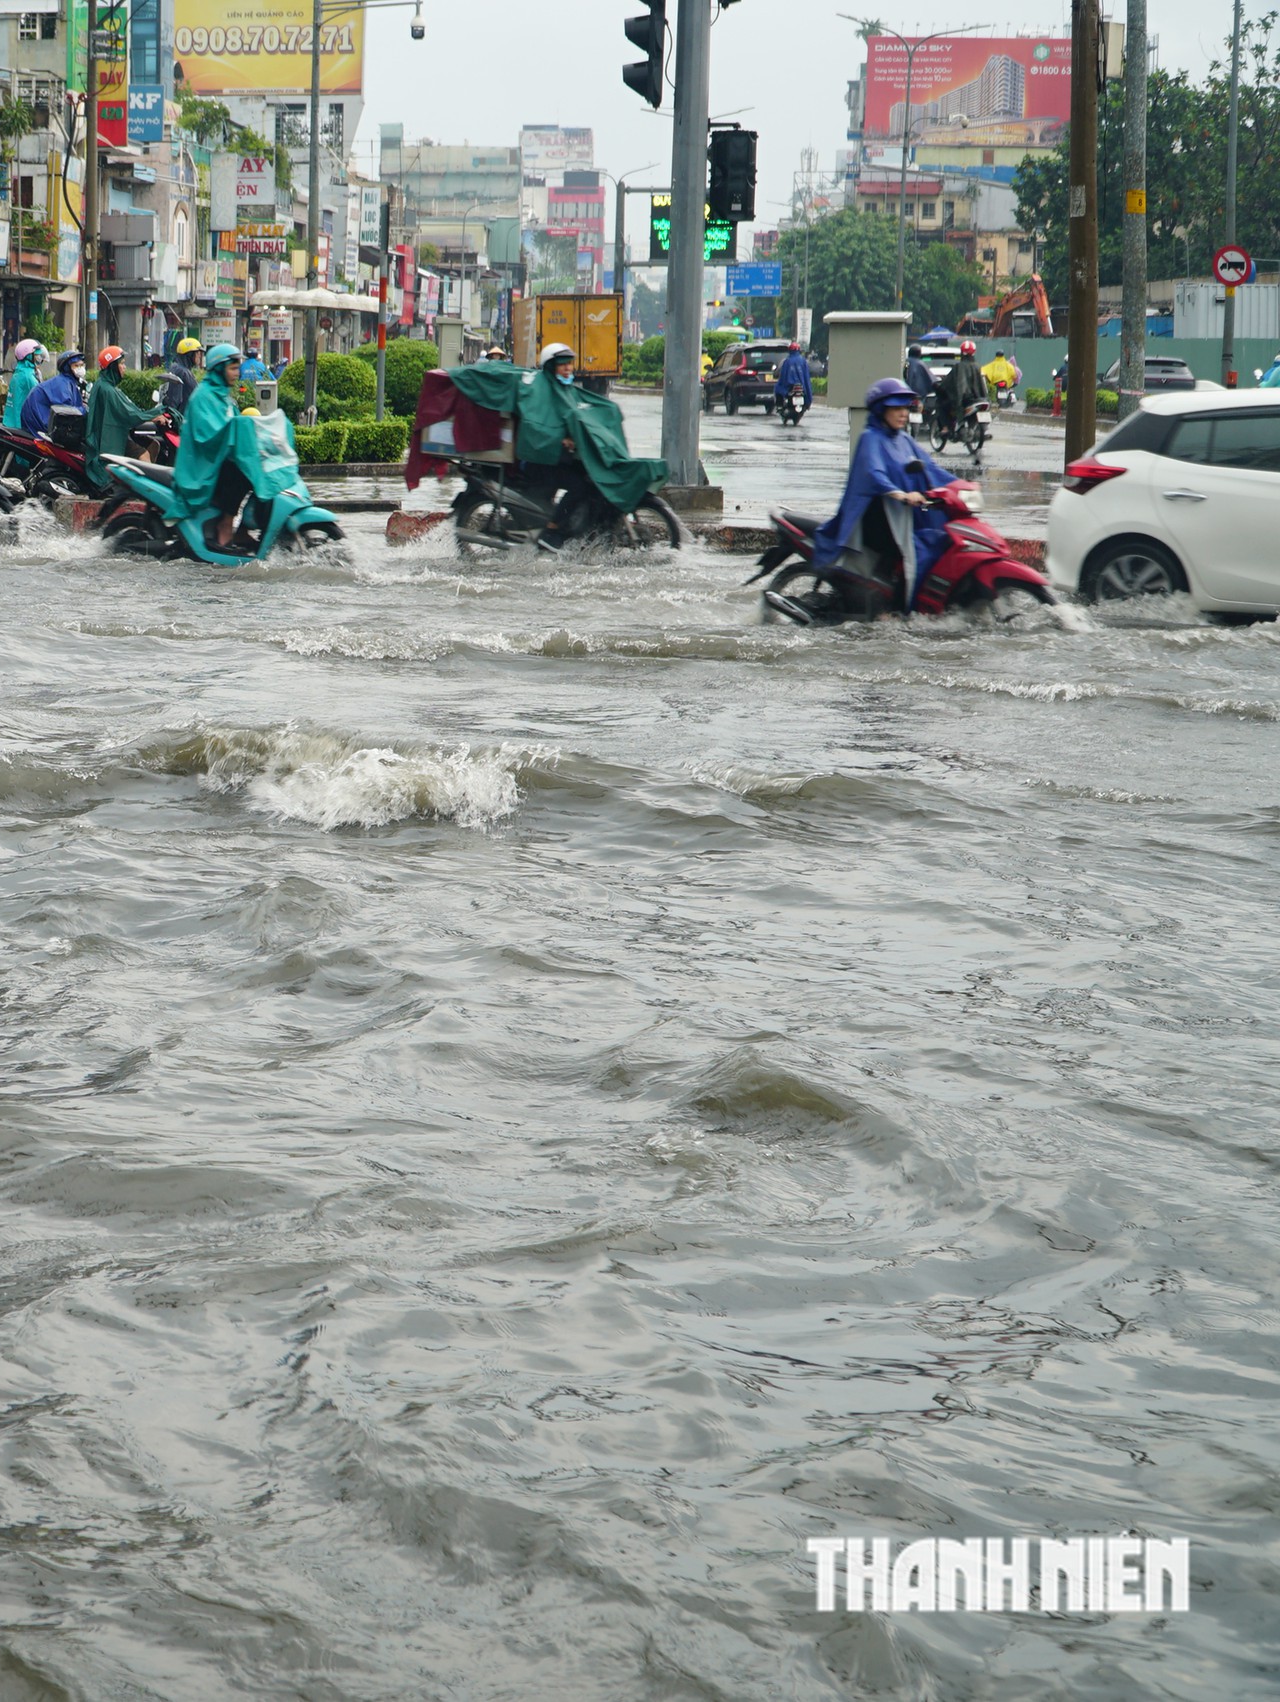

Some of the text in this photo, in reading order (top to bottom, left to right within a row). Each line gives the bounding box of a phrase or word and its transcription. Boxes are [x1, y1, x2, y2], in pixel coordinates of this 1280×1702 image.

[175, 26, 355, 55] 0908.70.72.71
[874, 44, 953, 52] DIAMOND SKY
[1039, 66, 1072, 75] 1800 63
[237, 158, 268, 173] AY
[236, 180, 258, 200] ỆN
